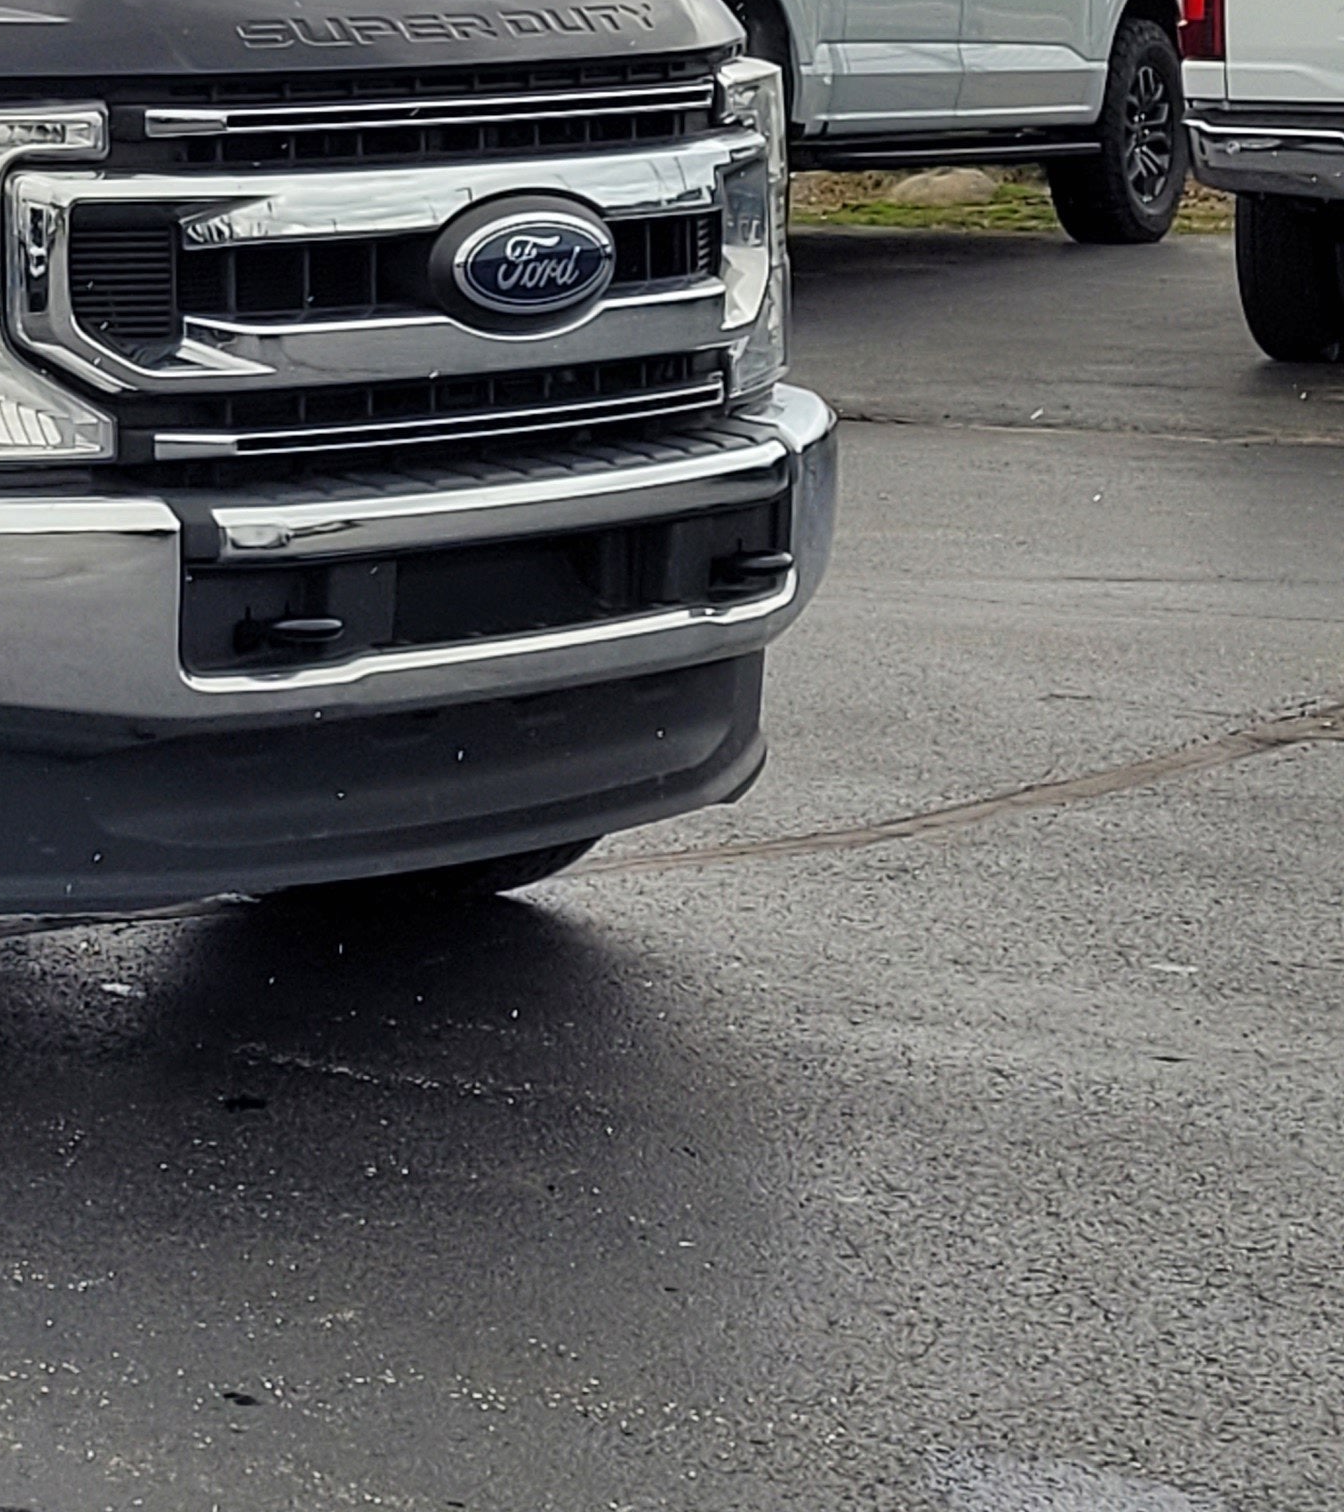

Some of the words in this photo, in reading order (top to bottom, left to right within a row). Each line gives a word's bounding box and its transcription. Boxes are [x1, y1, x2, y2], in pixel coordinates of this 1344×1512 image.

[236, 12, 497, 49] SUPER
[499, 3, 655, 37] DUTY
[496, 234, 580, 289] Ford
